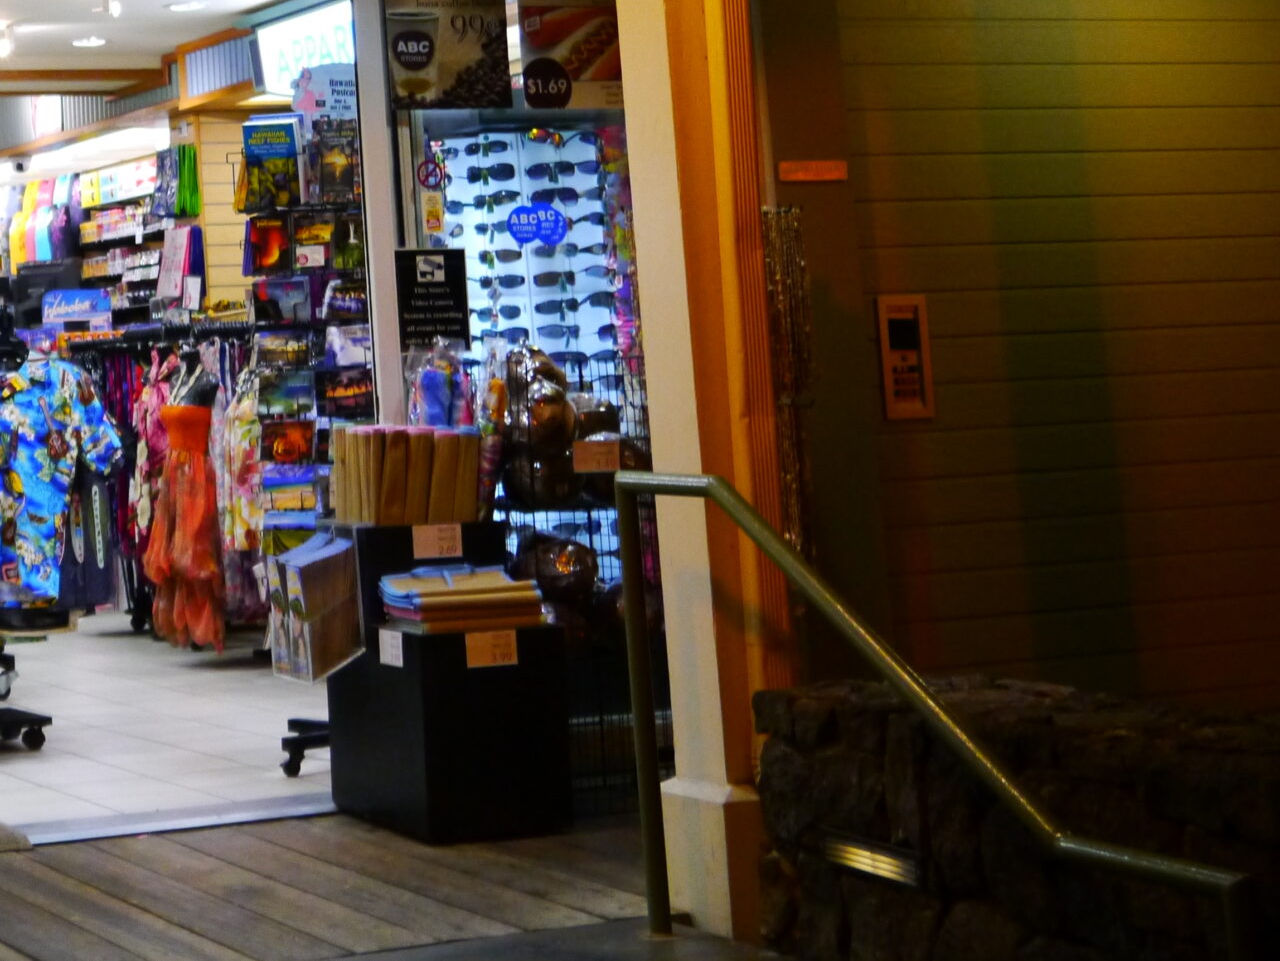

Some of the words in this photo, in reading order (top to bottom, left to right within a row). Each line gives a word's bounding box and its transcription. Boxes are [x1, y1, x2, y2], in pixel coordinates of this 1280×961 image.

[397, 40, 430, 53] ABC
[401, 54, 427, 62] STORES
[527, 79, 567, 95] $1.69
[511, 214, 538, 224] ABC
